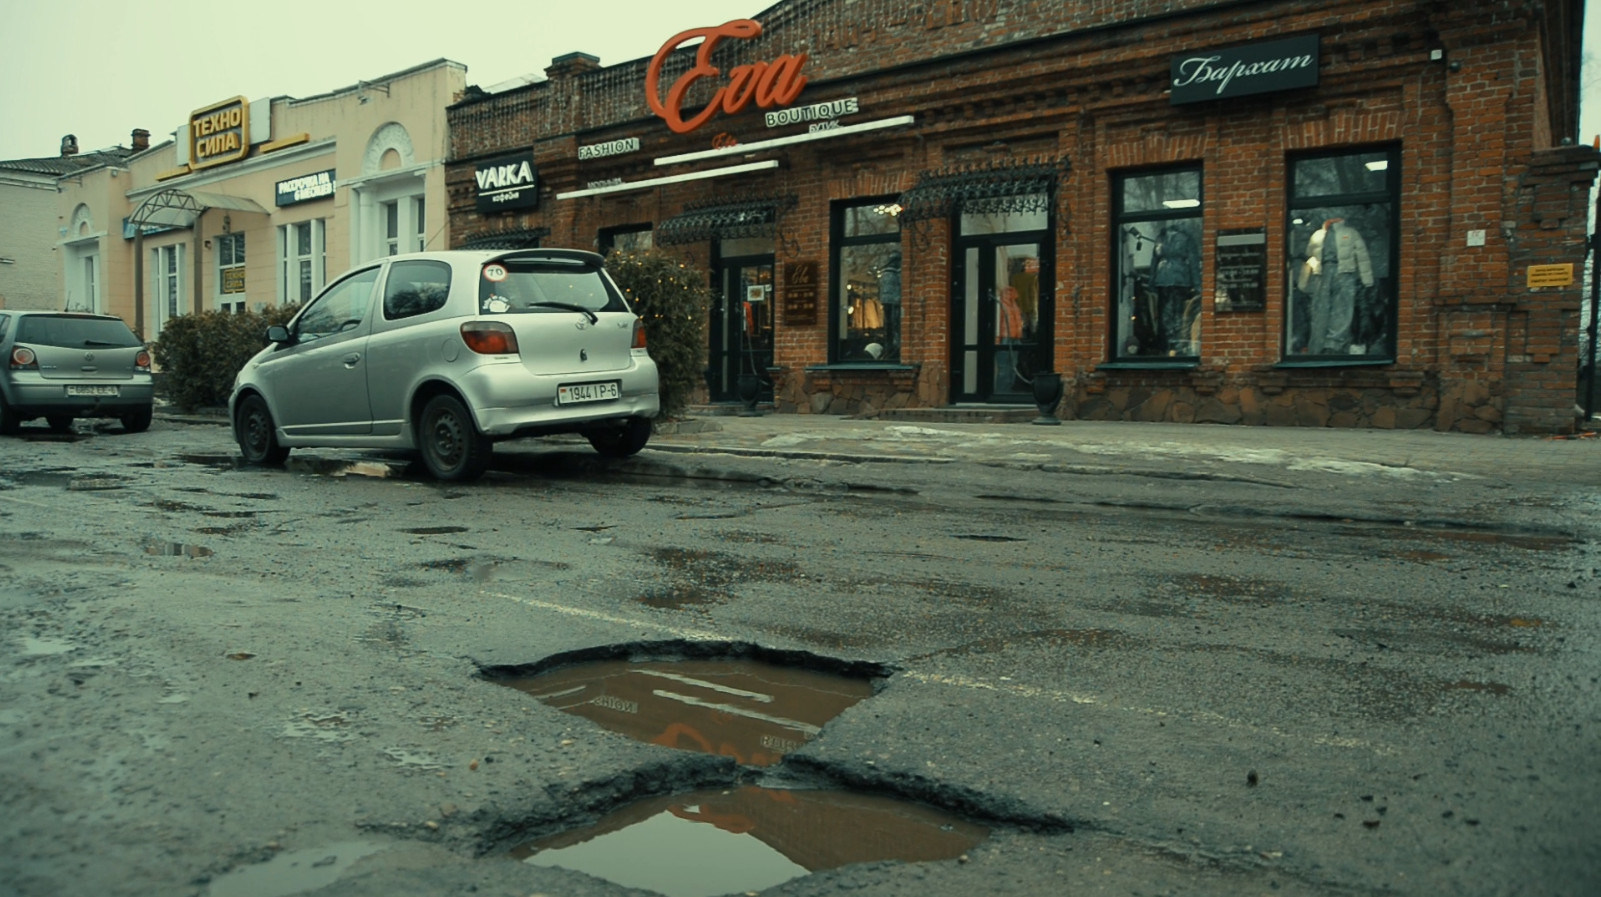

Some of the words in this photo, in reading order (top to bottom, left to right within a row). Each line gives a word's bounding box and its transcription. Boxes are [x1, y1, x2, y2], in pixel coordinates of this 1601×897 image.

[645, 19, 809, 134] Eva
[1173, 54, 1314, 95] Бархат
[193, 107, 242, 138] ТЕХНО
[765, 98, 859, 128] BOUTIQUE
[196, 131, 239, 158] СИЛА
[578, 137, 639, 160] FASHION
[475, 160, 534, 189] VARKA
[487, 268, 503, 277] 70
[569, 387, 592, 401] 1944
